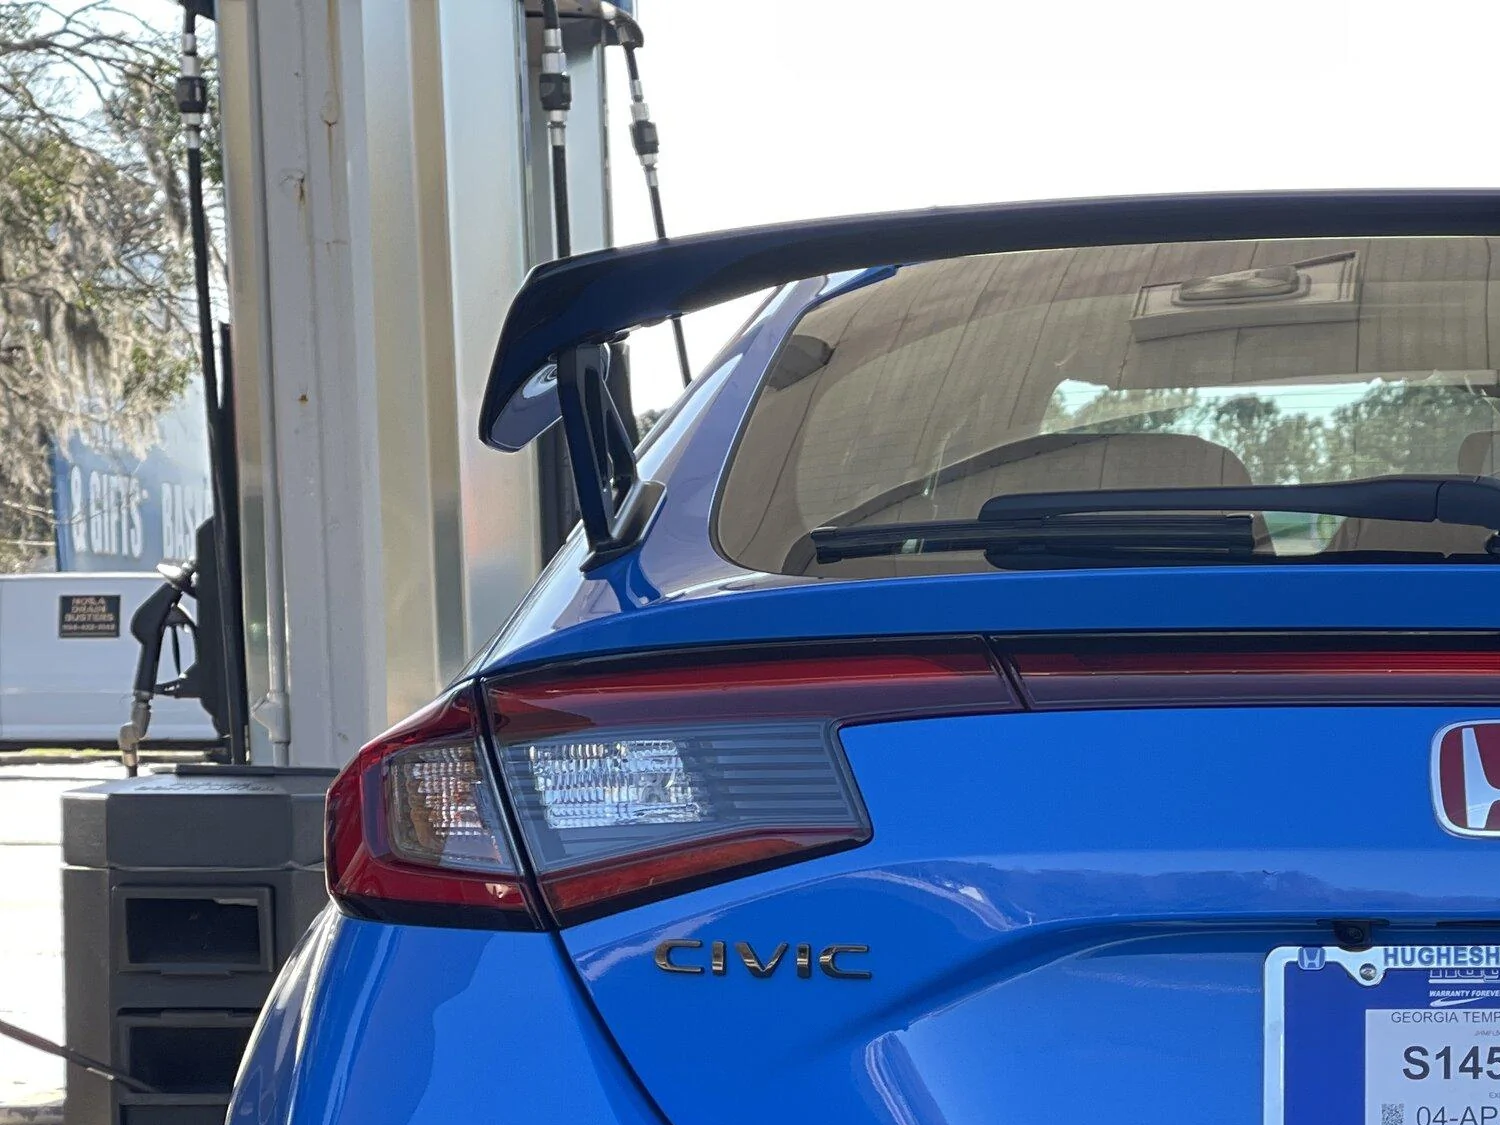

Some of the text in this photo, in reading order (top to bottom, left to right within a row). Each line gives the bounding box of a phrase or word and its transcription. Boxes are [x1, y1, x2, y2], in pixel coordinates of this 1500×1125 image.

[654, 938, 872, 981] CIVIC
[1429, 989, 1471, 998] WARRANTY
[1391, 1011, 1459, 1024] GEORGIA
